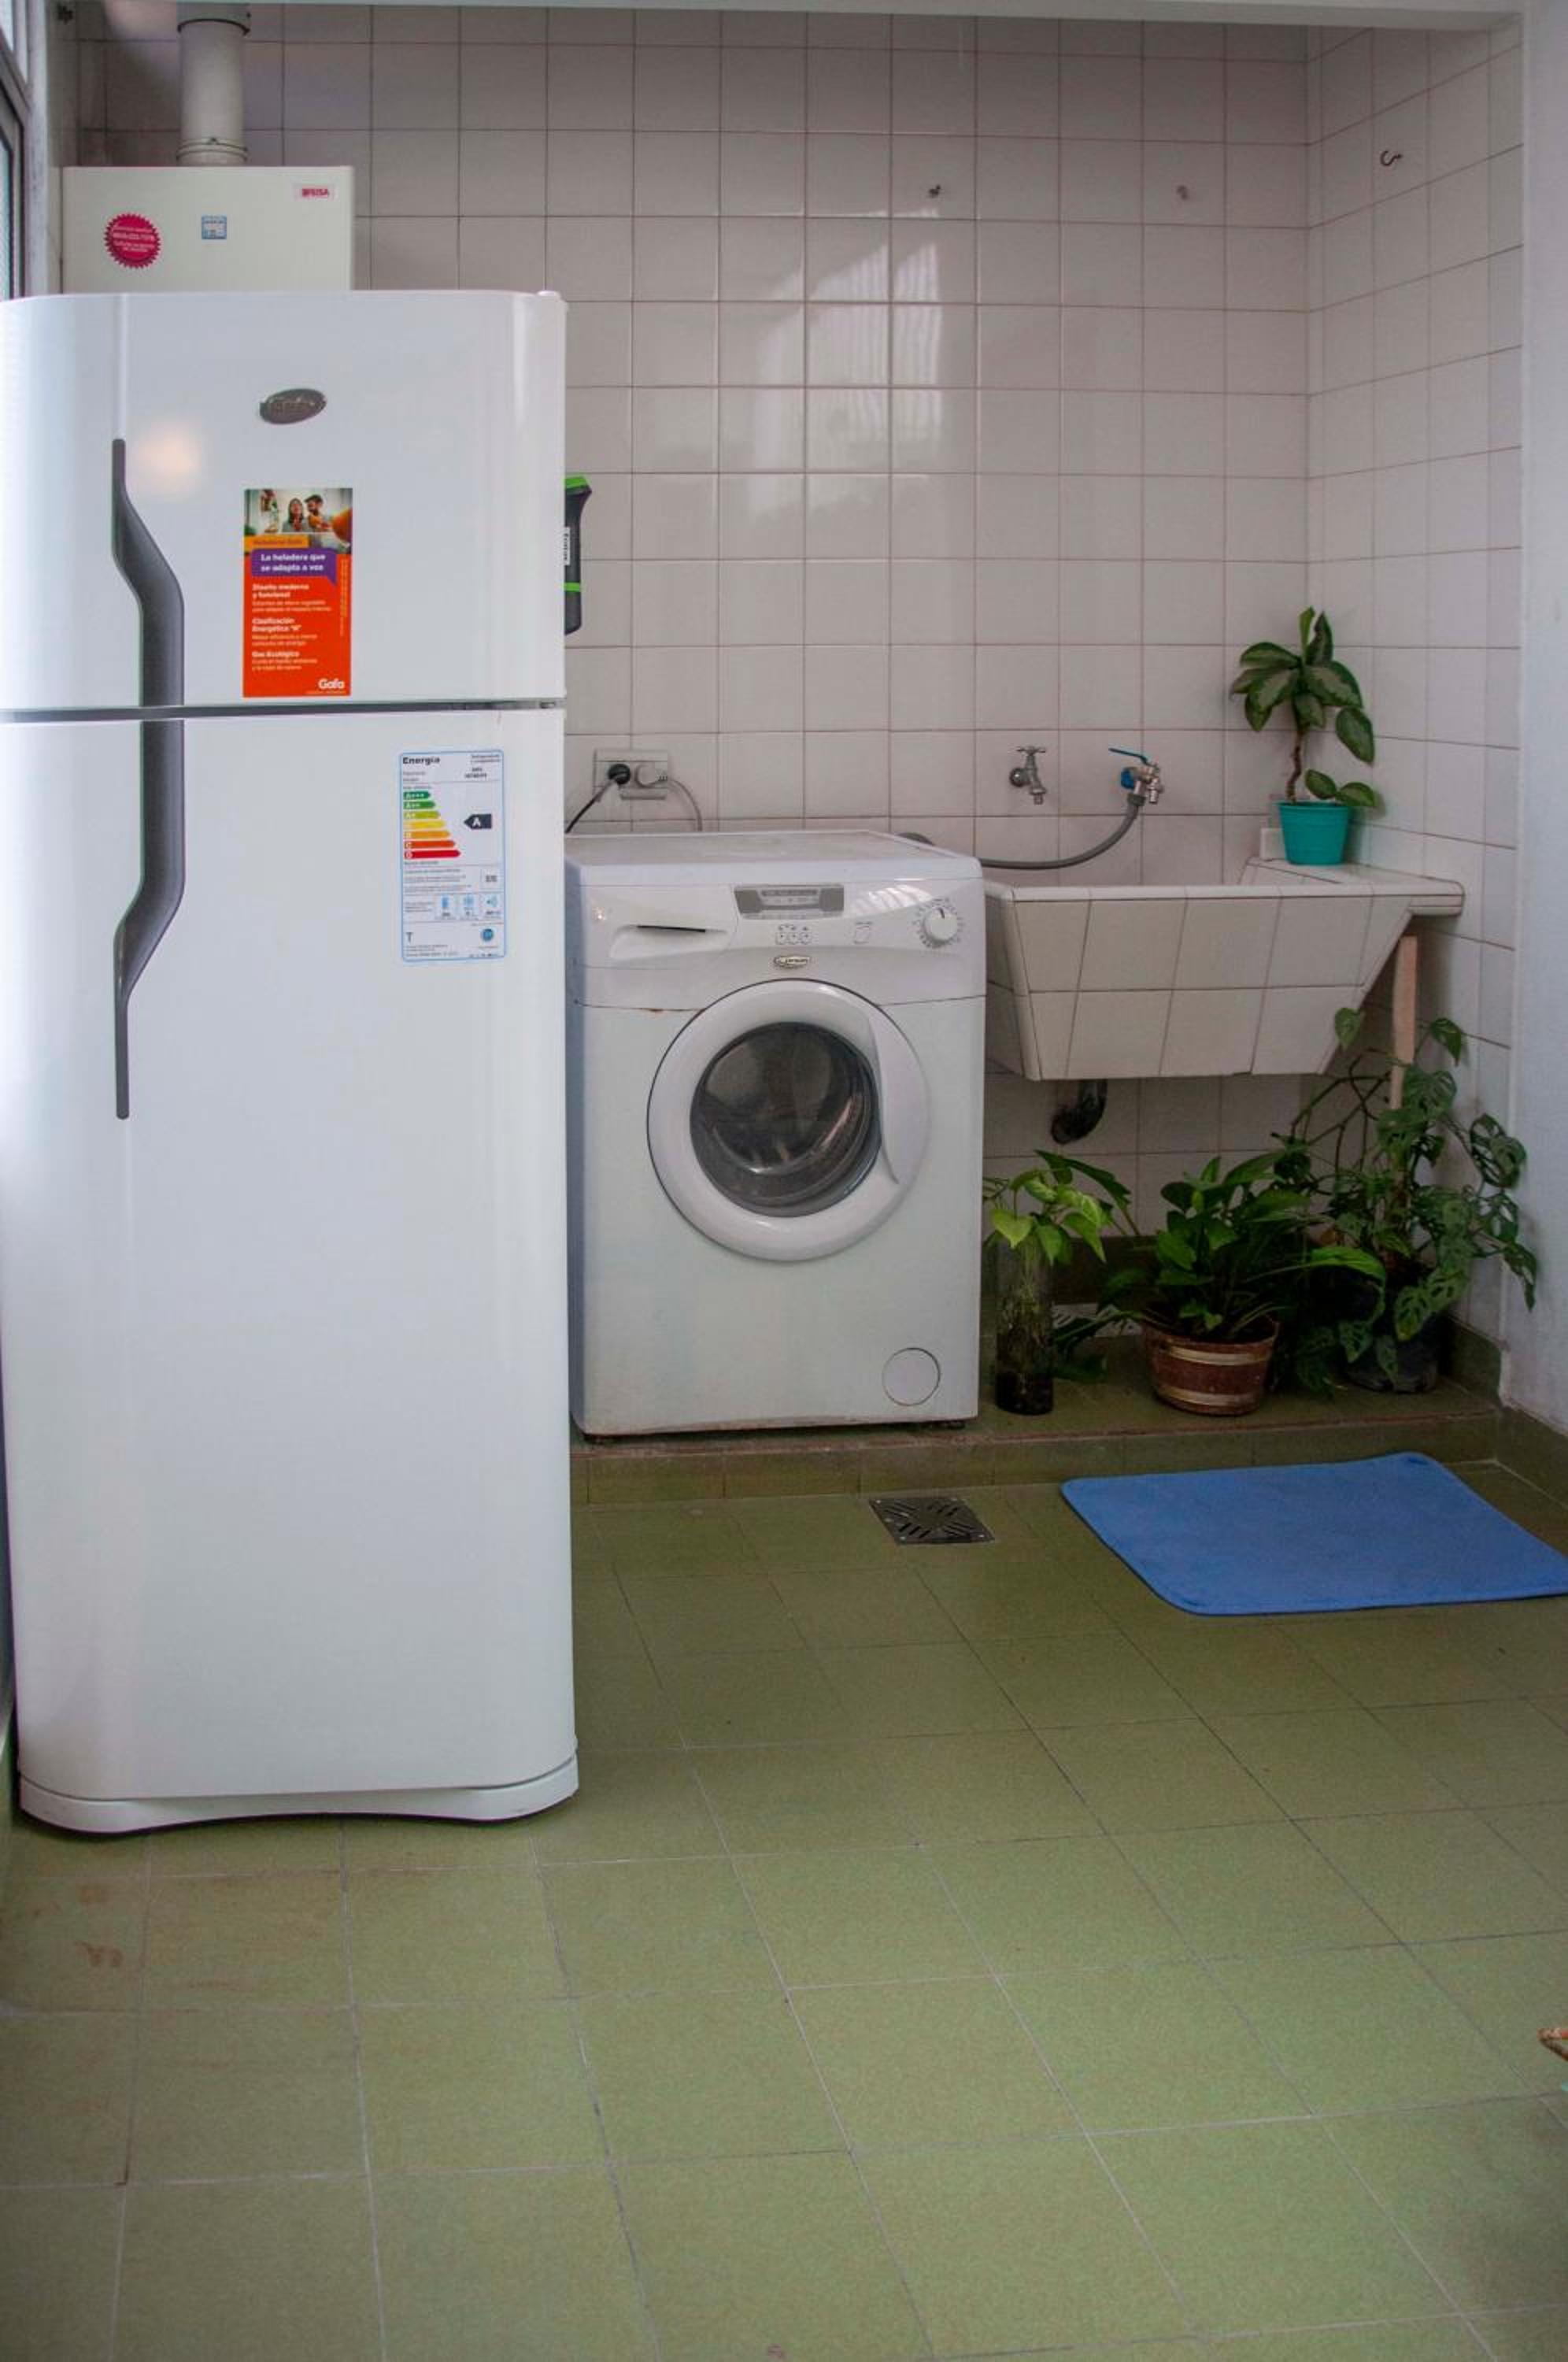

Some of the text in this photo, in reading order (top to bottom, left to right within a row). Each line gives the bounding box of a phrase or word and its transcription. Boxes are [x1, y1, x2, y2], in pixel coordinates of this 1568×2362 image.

[272, 553, 307, 561] heladera
[309, 553, 326, 563] que
[272, 564, 300, 573] adapta
[318, 678, 345, 690] Gafa
[472, 816, 482, 827] A
